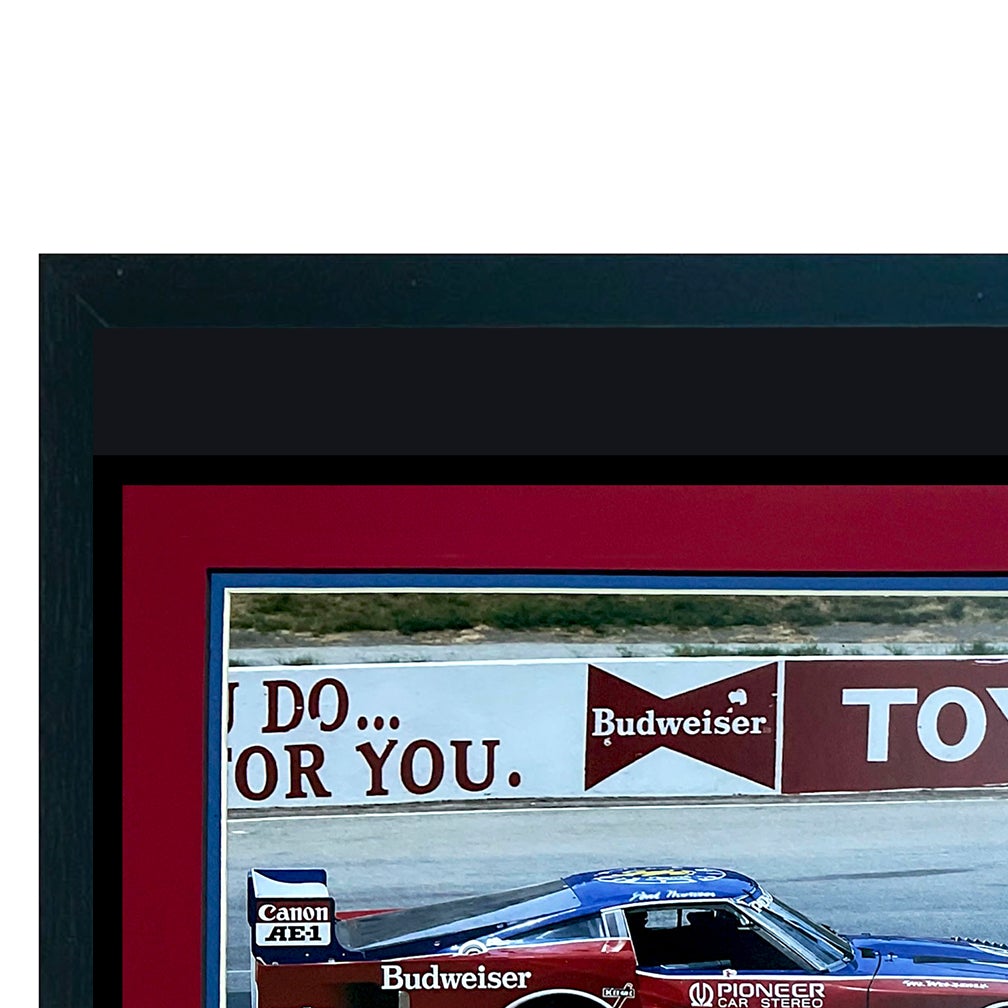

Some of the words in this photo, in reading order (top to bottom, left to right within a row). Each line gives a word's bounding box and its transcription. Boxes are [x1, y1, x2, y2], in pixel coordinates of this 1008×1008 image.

[592, 708, 767, 738] Budweiser
[228, 743, 333, 801] OR
[355, 739, 522, 797] YOU.
[258, 904, 328, 922] Canon
[265, 925, 322, 942] AE-1
[381, 965, 532, 990] Budweiser
[717, 983, 825, 998] PIONEER
[718, 998, 748, 1008] CAR
[761, 998, 823, 1008] STEREO
